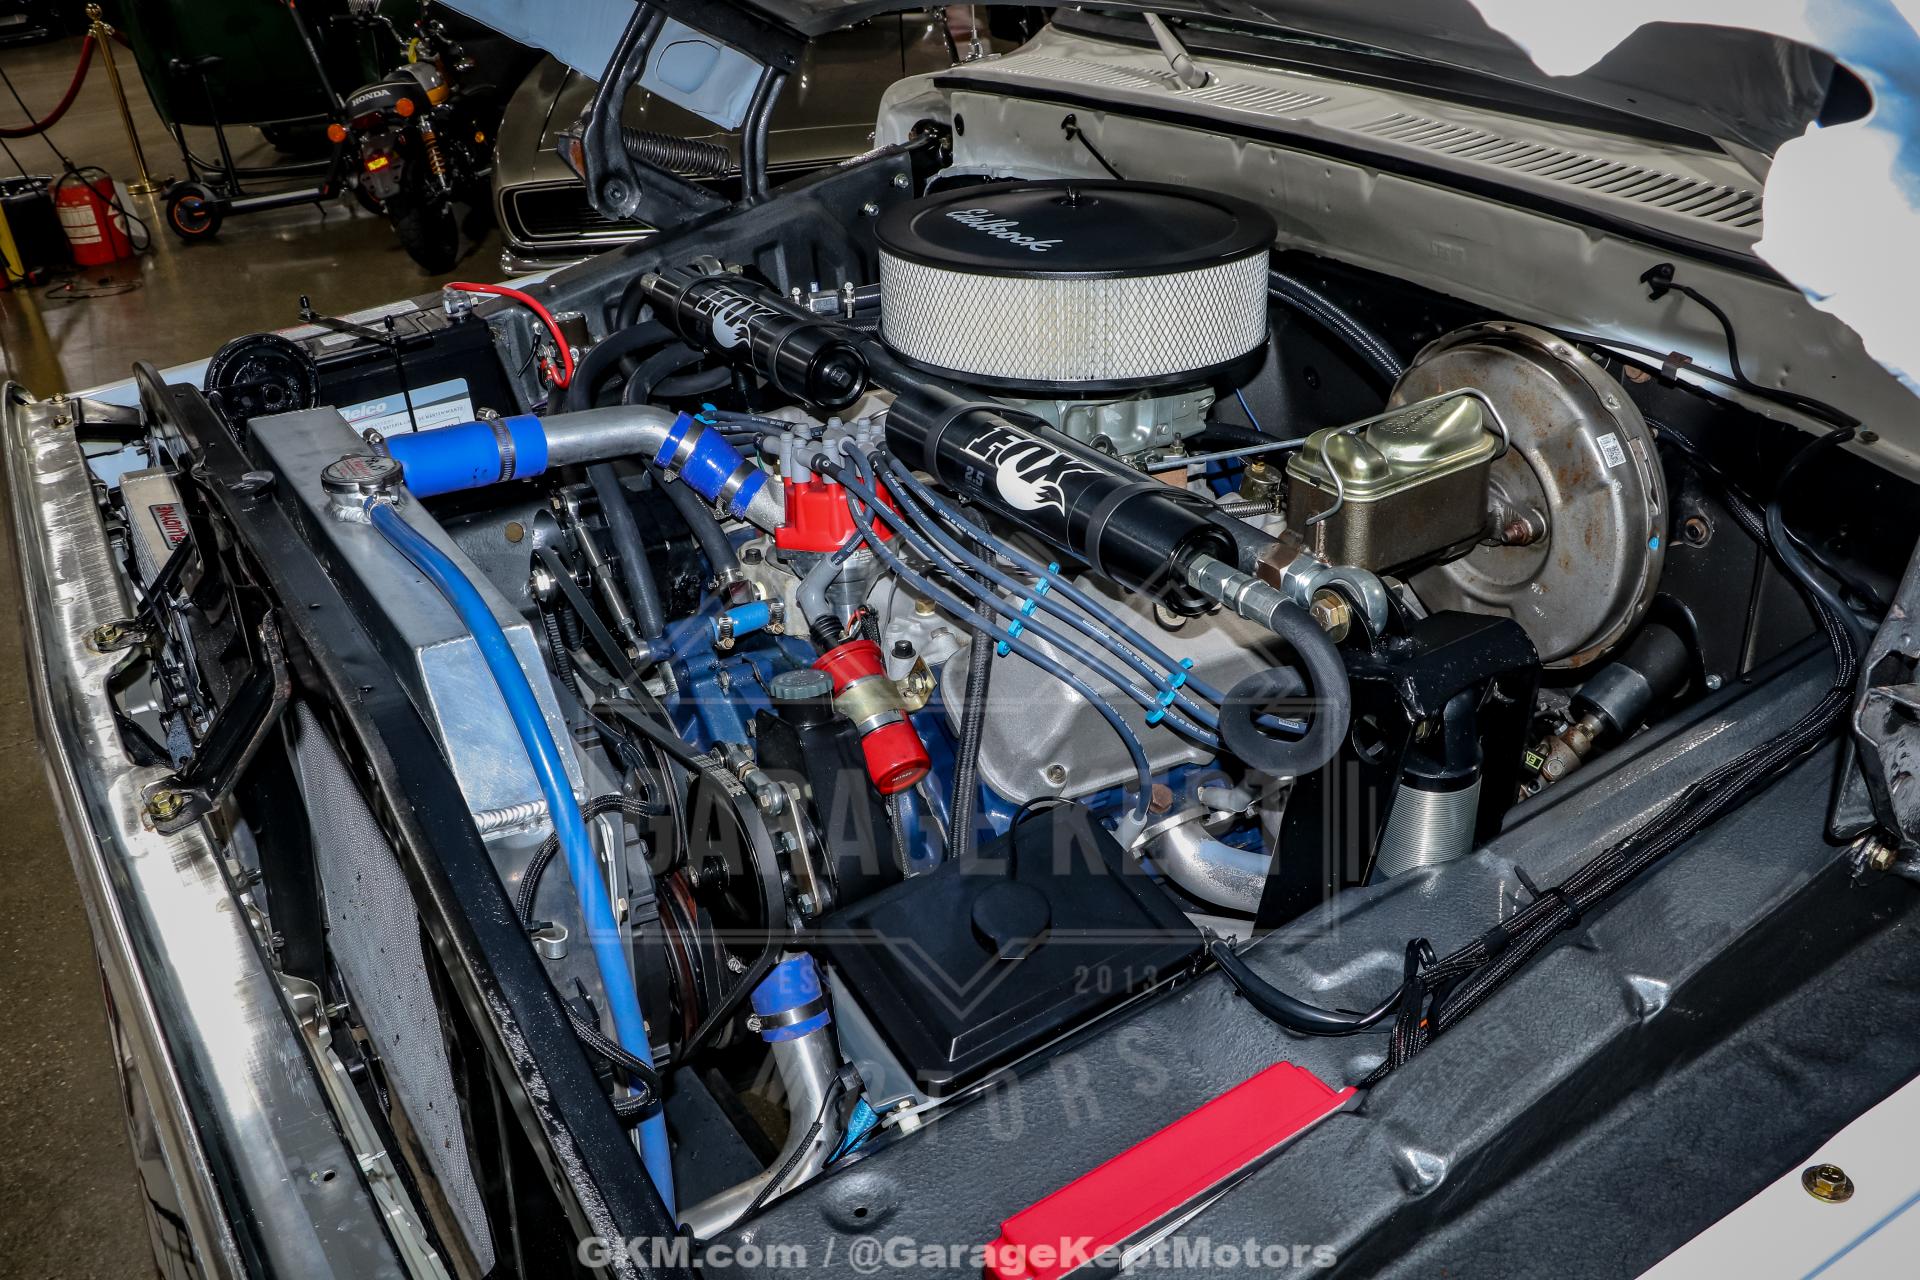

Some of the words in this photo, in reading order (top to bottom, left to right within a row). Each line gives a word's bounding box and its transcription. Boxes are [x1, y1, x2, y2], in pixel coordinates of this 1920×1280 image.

[351, 89, 391, 107] HONDA
[945, 208, 1064, 252] Edelbrock
[960, 425, 1105, 517] FOX
[963, 464, 986, 488] 2.5
